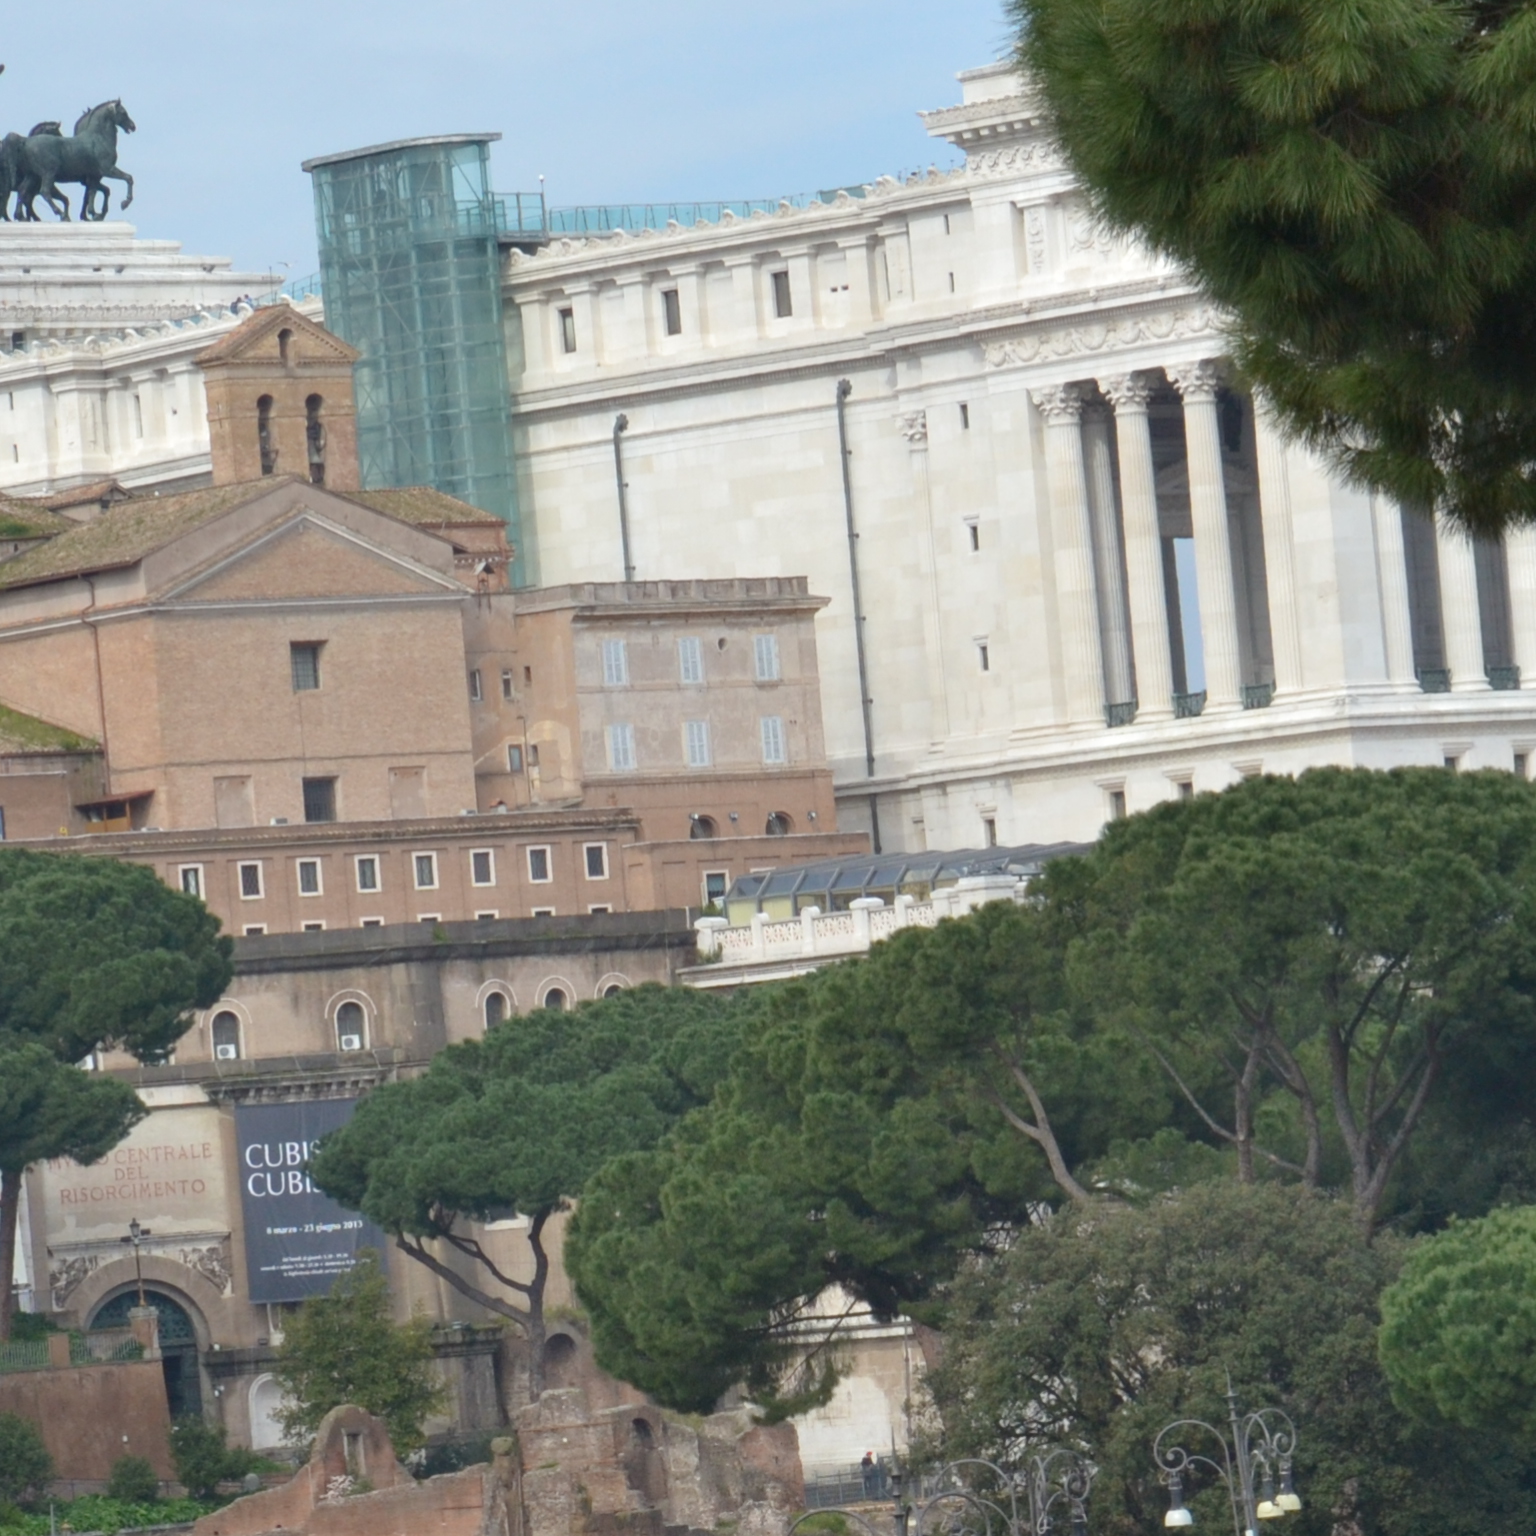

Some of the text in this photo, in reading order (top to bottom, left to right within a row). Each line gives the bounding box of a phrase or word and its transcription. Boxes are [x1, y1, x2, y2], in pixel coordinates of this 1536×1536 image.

[114, 1142, 212, 1166] CENTRALE
[114, 1166, 149, 1181] DEL
[60, 1179, 205, 1205] RISORCIMENTO
[343, 1220, 363, 1229] 2013
